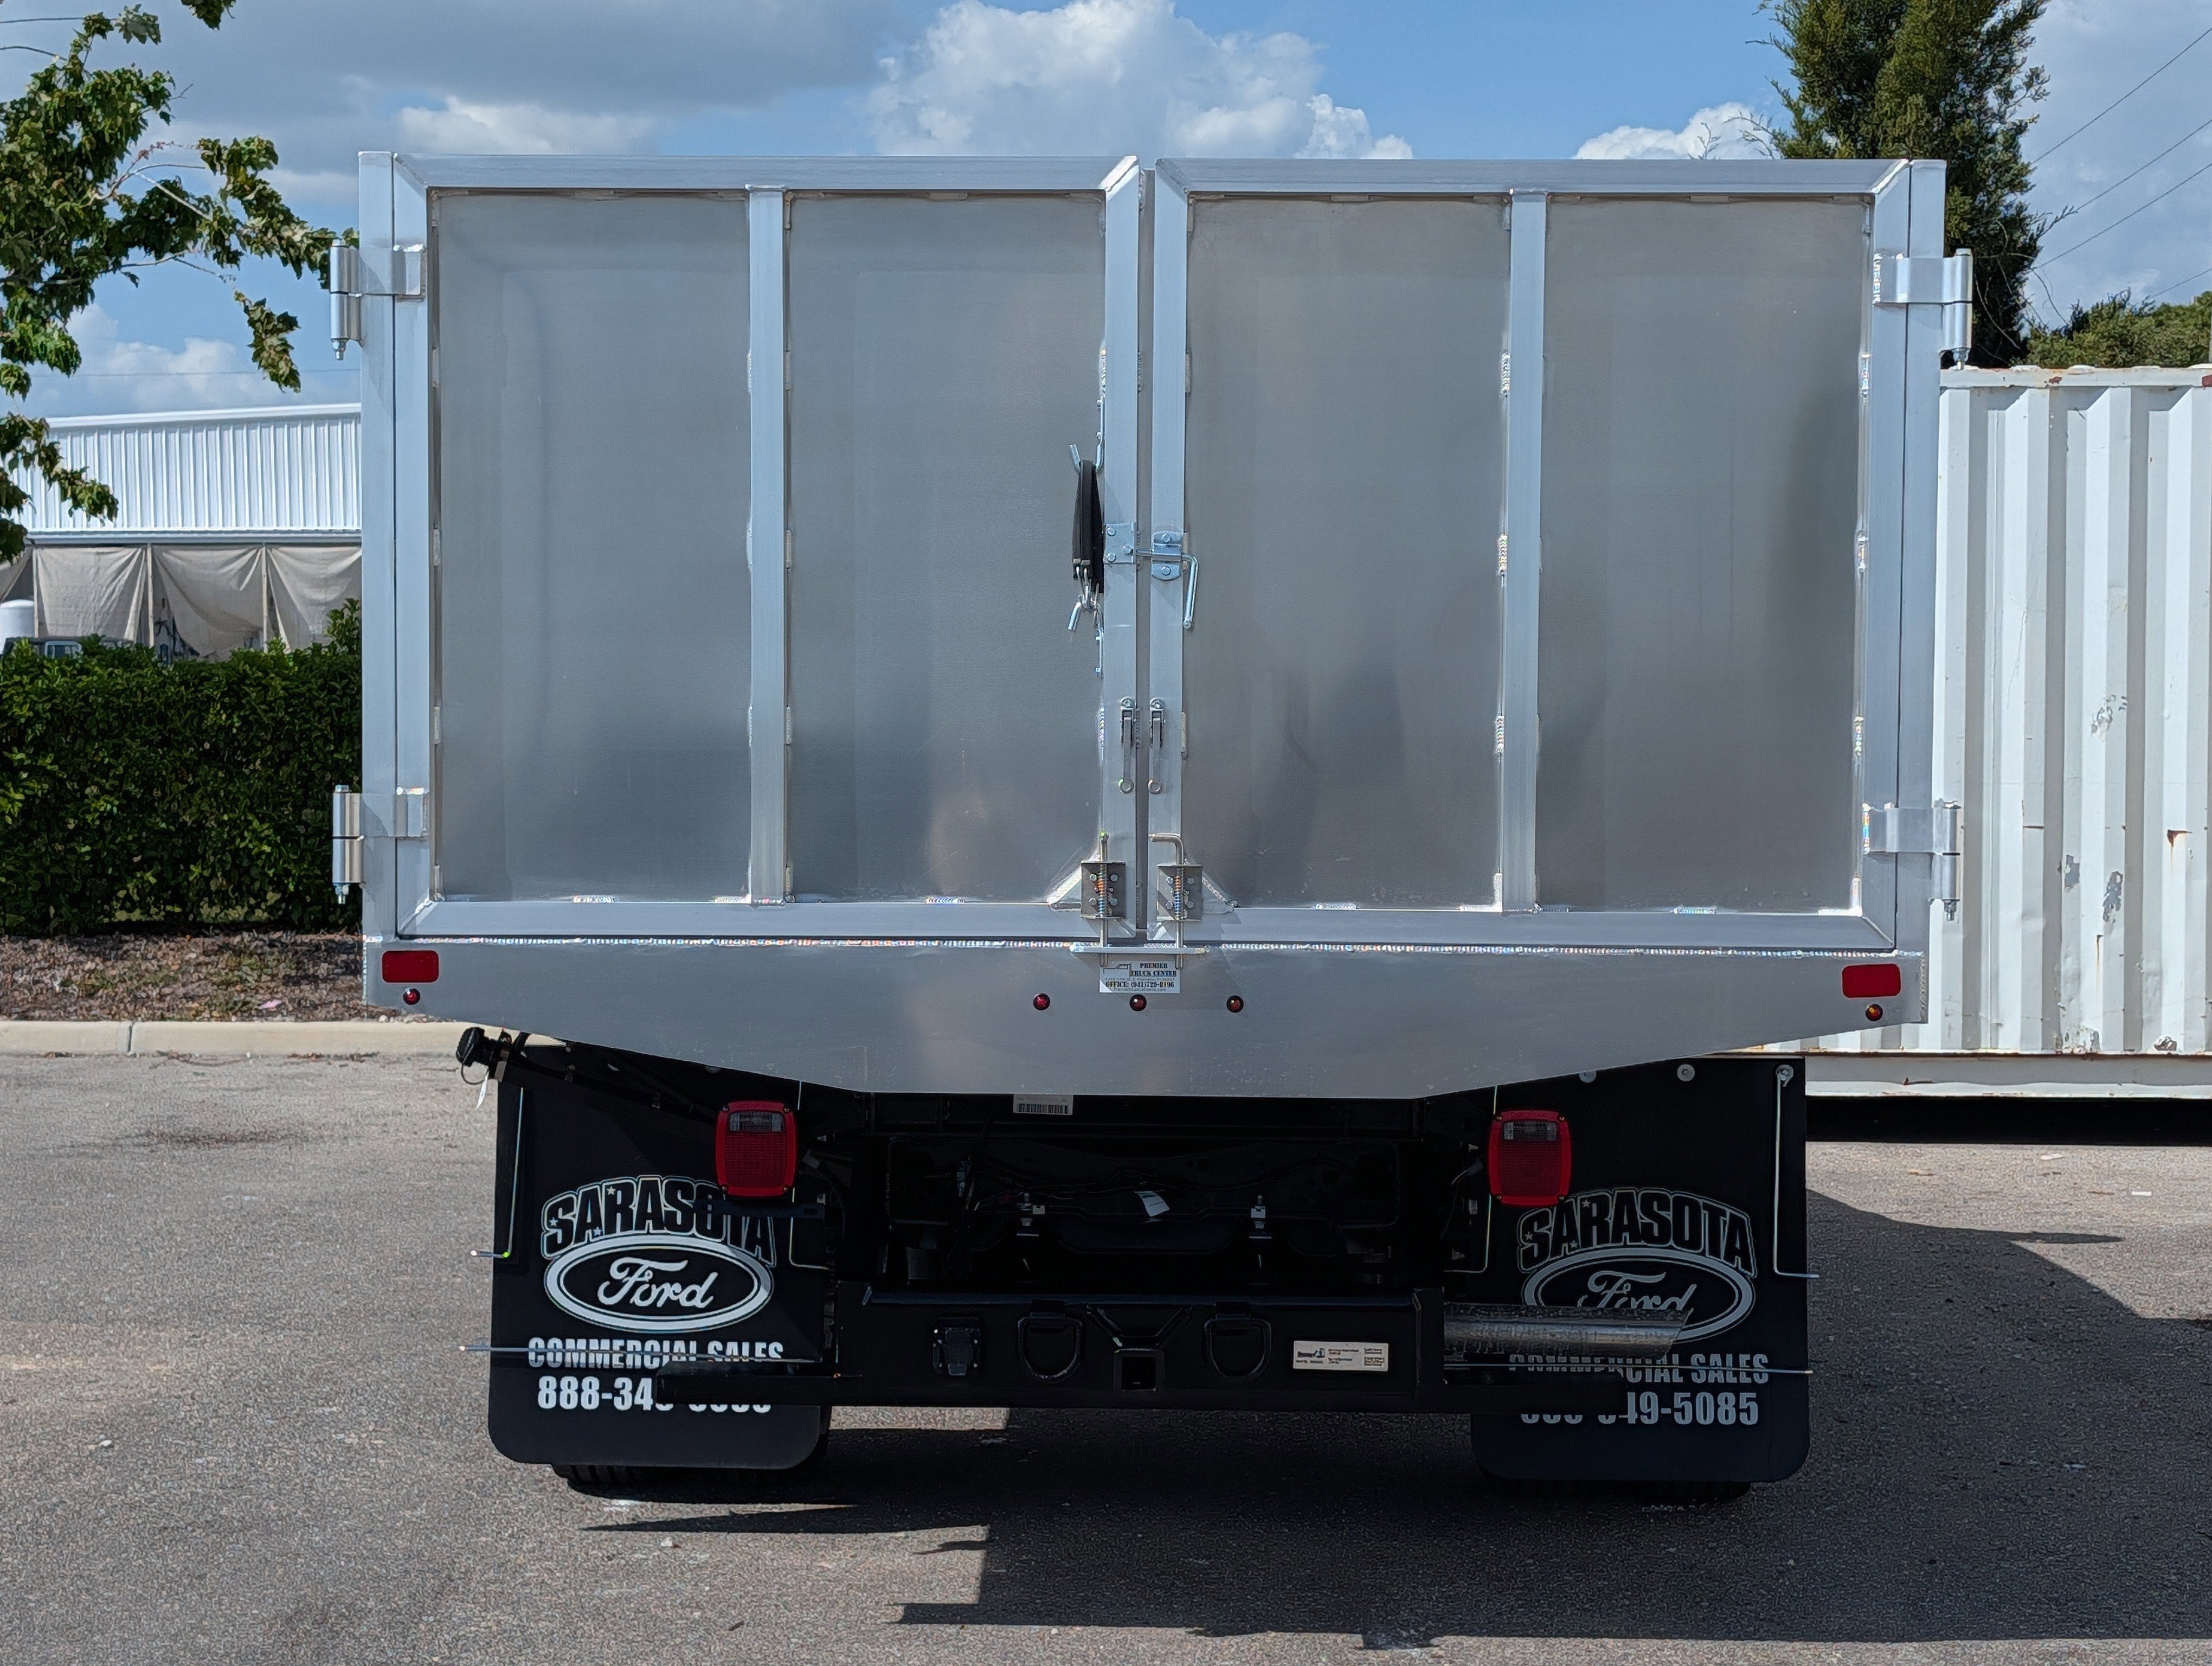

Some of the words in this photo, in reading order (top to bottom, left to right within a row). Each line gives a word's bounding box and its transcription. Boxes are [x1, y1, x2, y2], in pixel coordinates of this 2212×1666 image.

[1516, 1187, 1757, 1279] SARASOTA
[597, 1256, 719, 1309] Ford
[1690, 1353, 1769, 1384] SALES
[1520, 1391, 1759, 1425] 49-5085
